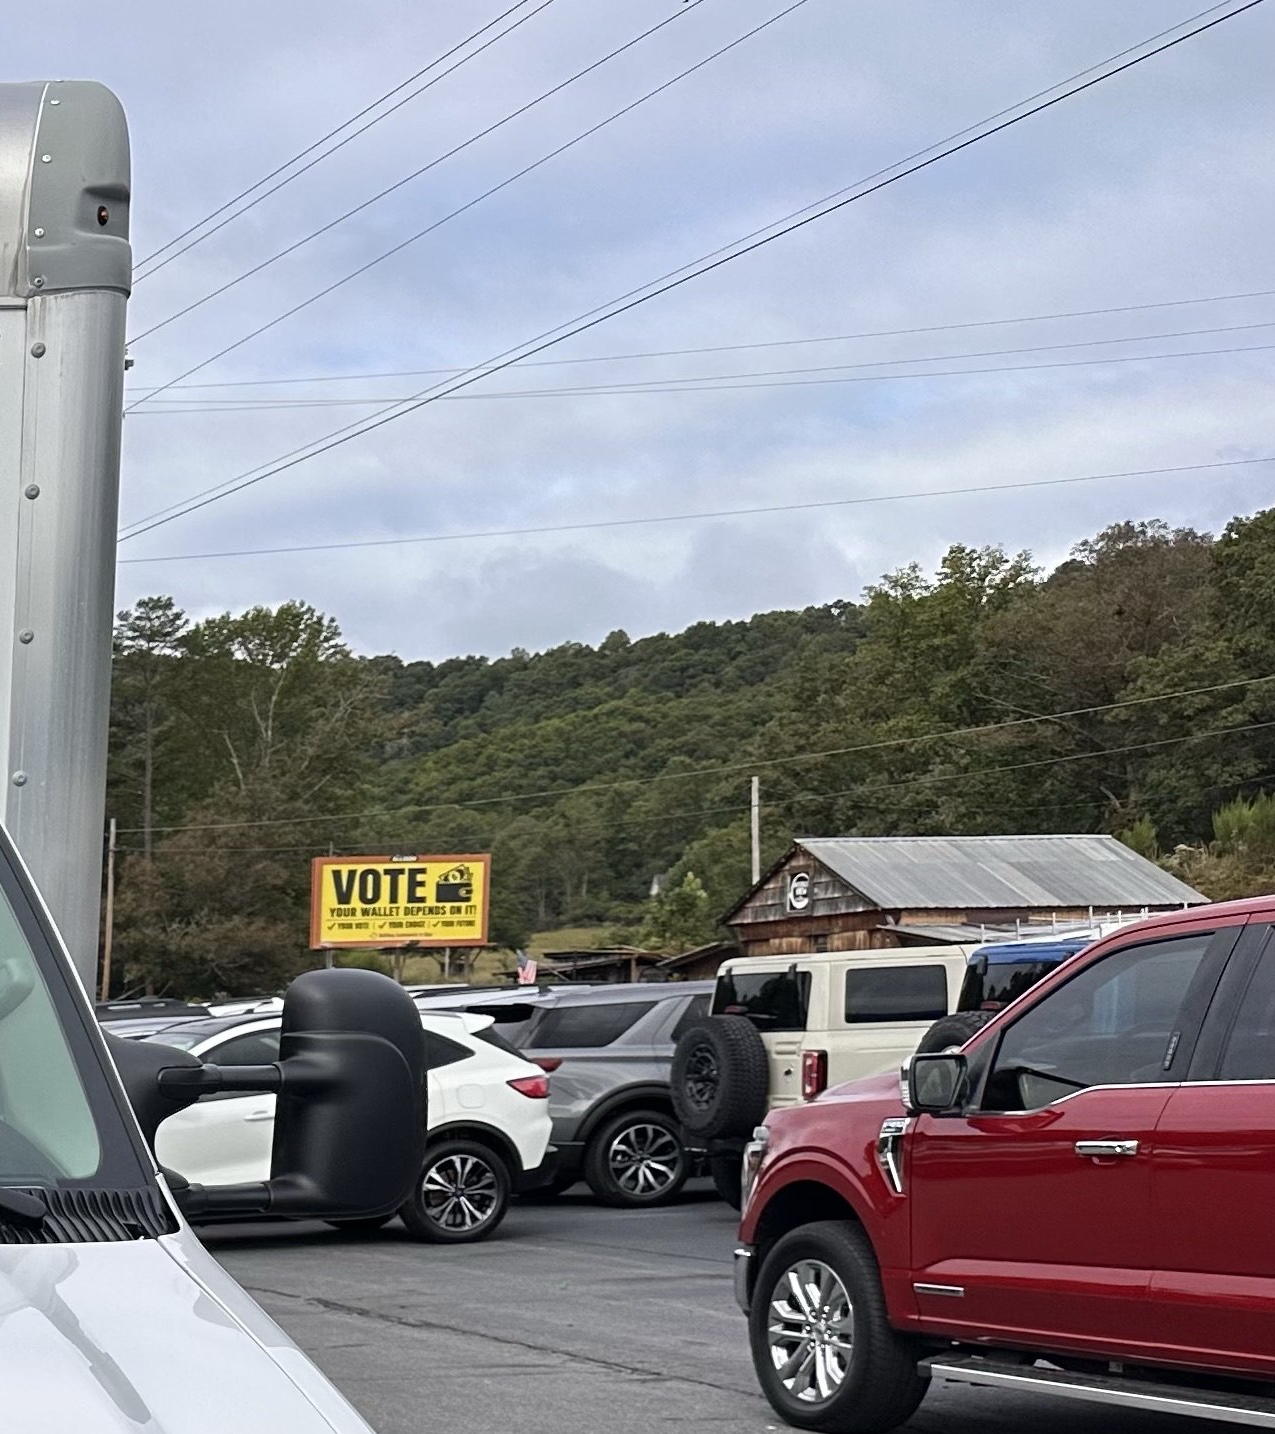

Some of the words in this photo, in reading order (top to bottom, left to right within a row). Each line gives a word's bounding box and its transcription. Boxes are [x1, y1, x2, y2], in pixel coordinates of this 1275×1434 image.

[331, 867, 428, 905] VOTE
[329, 907, 357, 918] YOUR
[361, 906, 401, 917] WALLET
[403, 905, 447, 916] DEPENDS
[449, 905, 463, 915] ON
[465, 904, 477, 914] IT!
